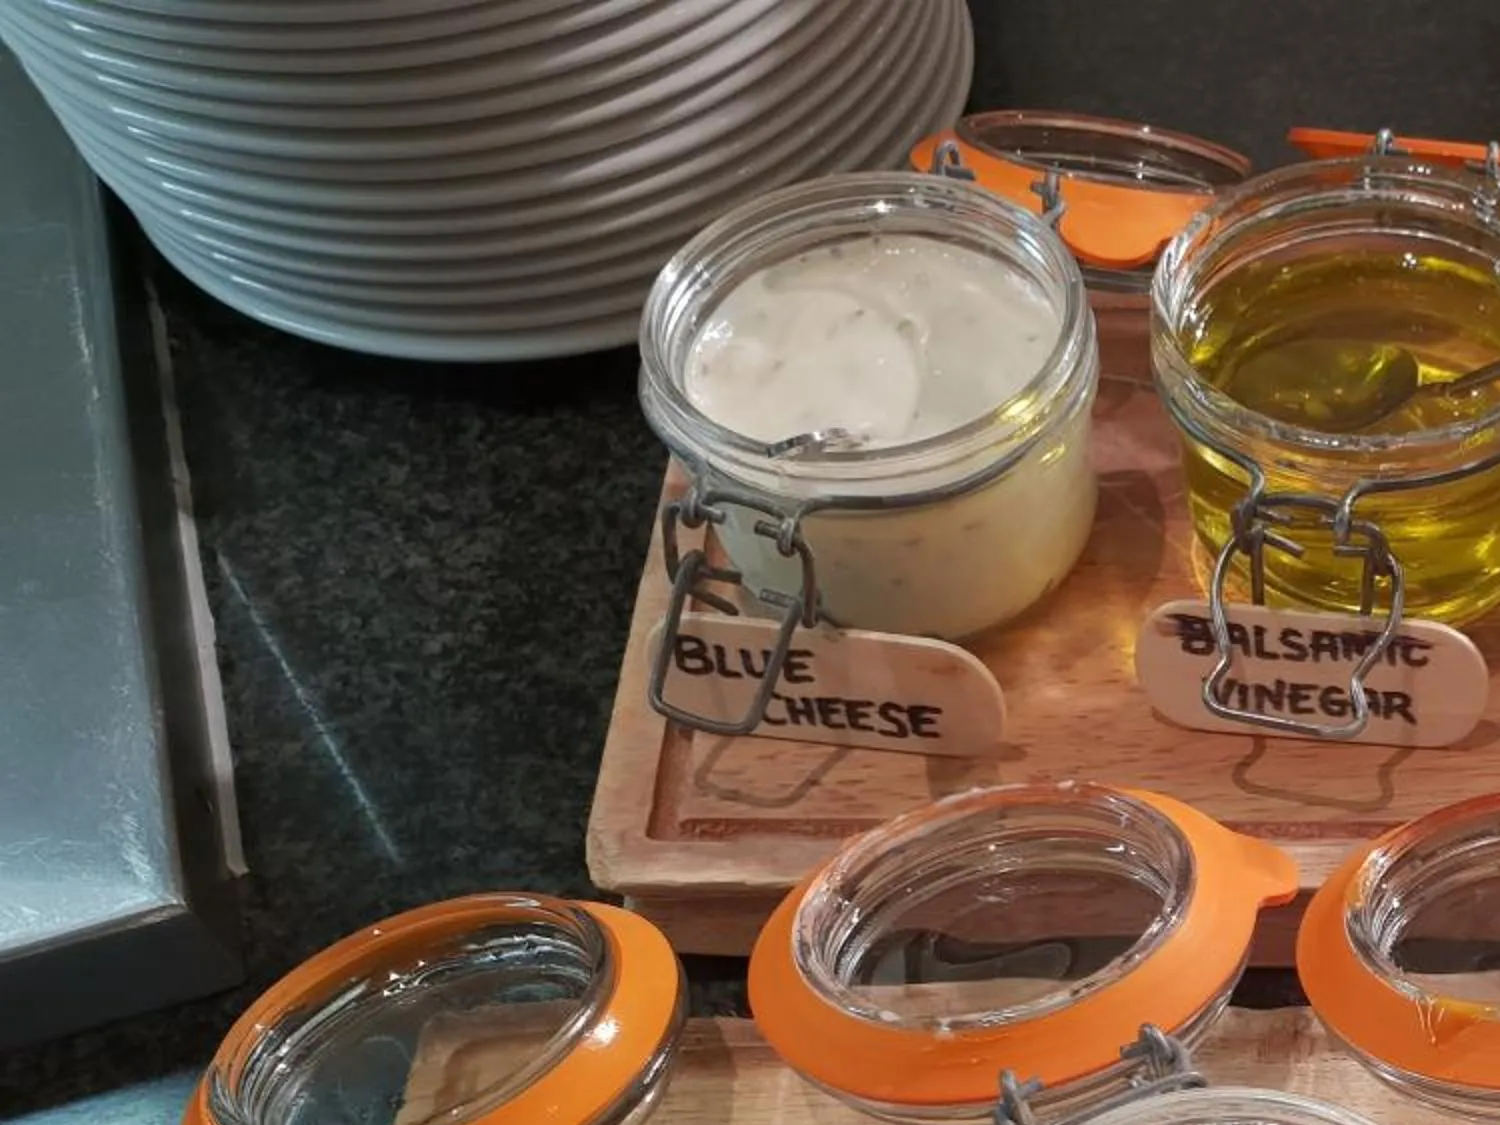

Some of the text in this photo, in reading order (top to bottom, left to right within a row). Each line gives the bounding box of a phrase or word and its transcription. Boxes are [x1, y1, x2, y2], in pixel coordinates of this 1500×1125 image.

[674, 634, 816, 684] BLUE
[1168, 613, 1433, 668] BALSAMIC
[762, 691, 943, 739] CHEESE
